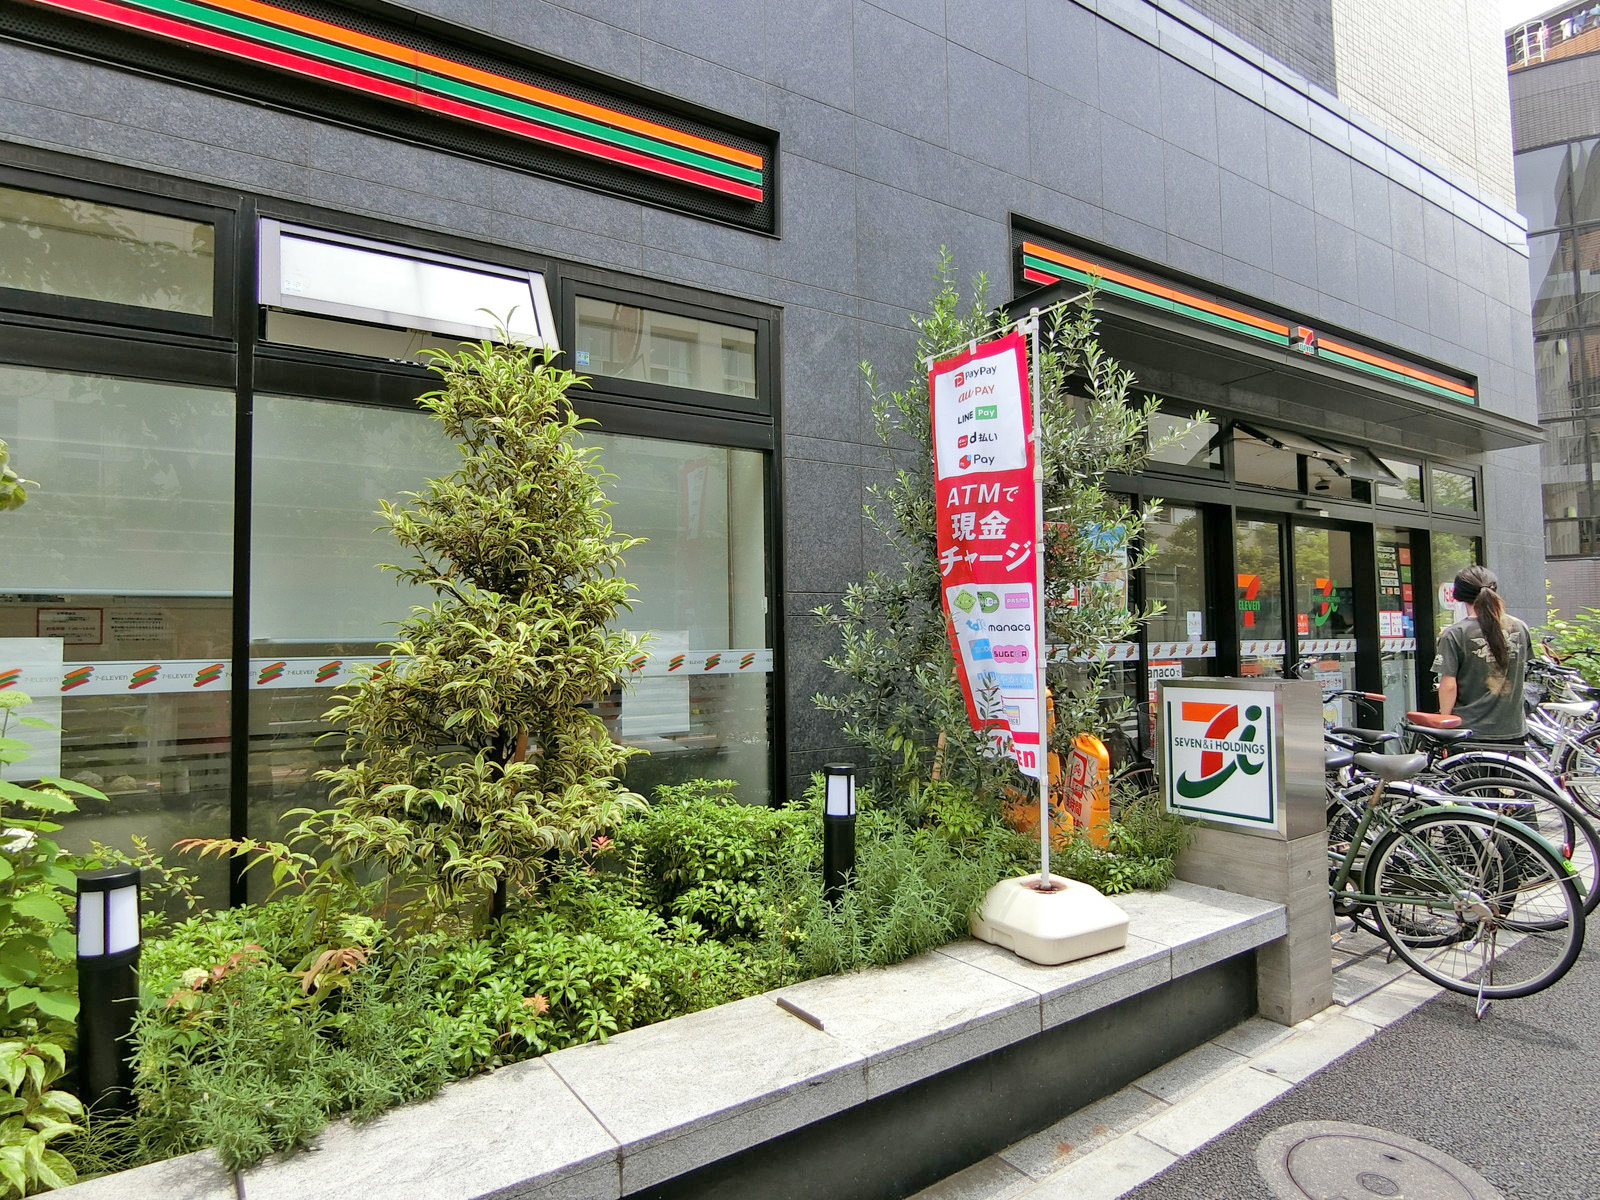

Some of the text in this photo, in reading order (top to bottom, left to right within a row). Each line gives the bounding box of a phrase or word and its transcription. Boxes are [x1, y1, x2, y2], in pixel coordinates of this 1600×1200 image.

[965, 366, 997, 380] PayPay
[975, 385, 995, 396] PAY
[957, 409, 995, 424] LINE Pay
[973, 454, 995, 465] Pay
[946, 483, 1019, 508] ATMで
[951, 510, 1011, 541] 現金
[940, 540, 1032, 577] チャージ
[988, 624, 1031, 632] manaca
[1147, 668, 1176, 679] anaco
[1215, 741, 1265, 755] HOLDINGS
